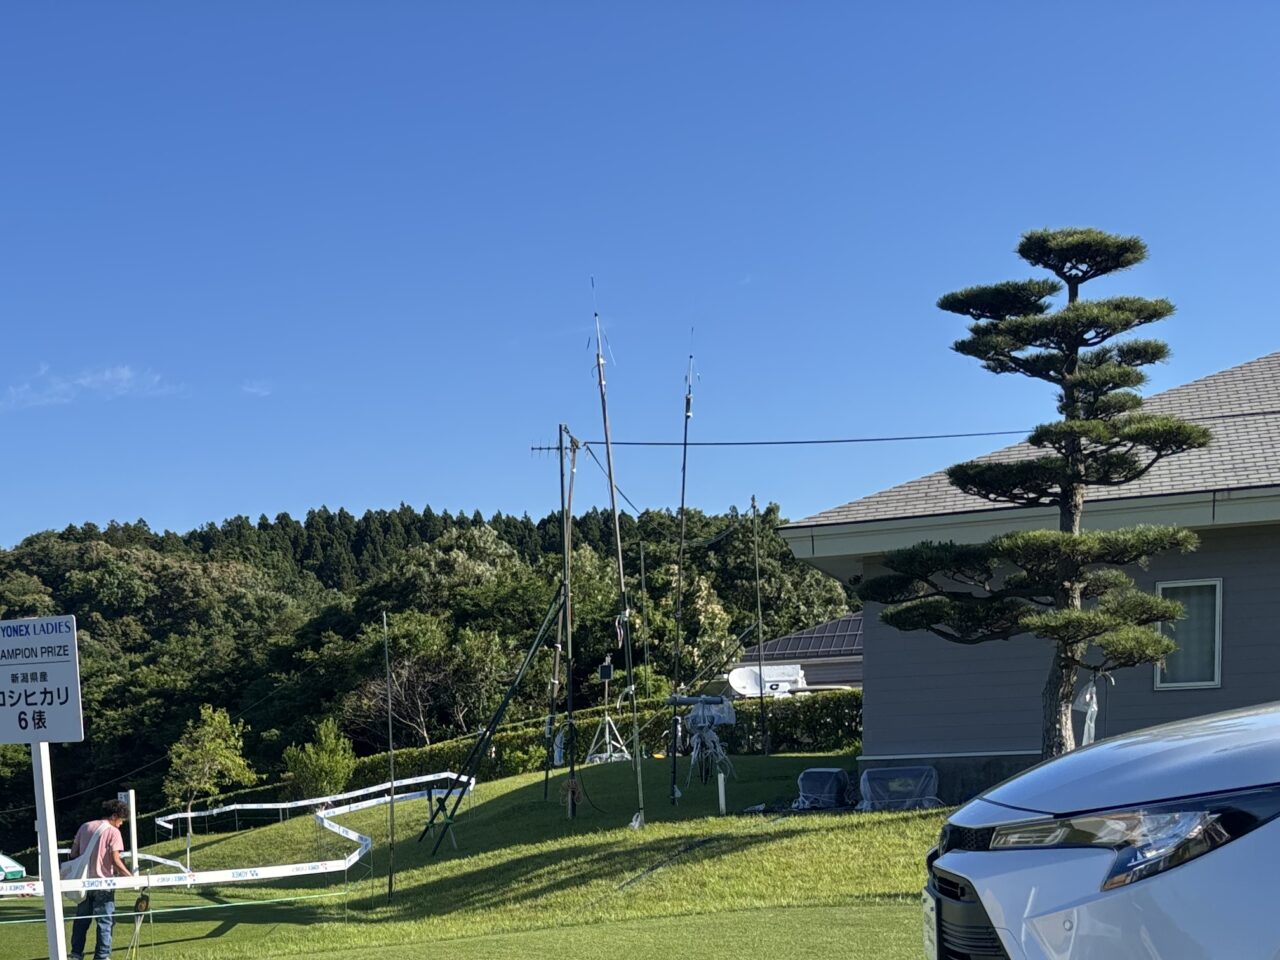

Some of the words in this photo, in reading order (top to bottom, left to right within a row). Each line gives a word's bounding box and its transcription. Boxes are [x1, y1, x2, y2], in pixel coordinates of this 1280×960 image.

[1, 623, 31, 638] YONEX
[33, 620, 71, 636] LADIES
[40, 644, 69, 658] PRIZE
[10, 671, 48, 684] 新潟県産
[18, 710, 47, 730] 6俵
